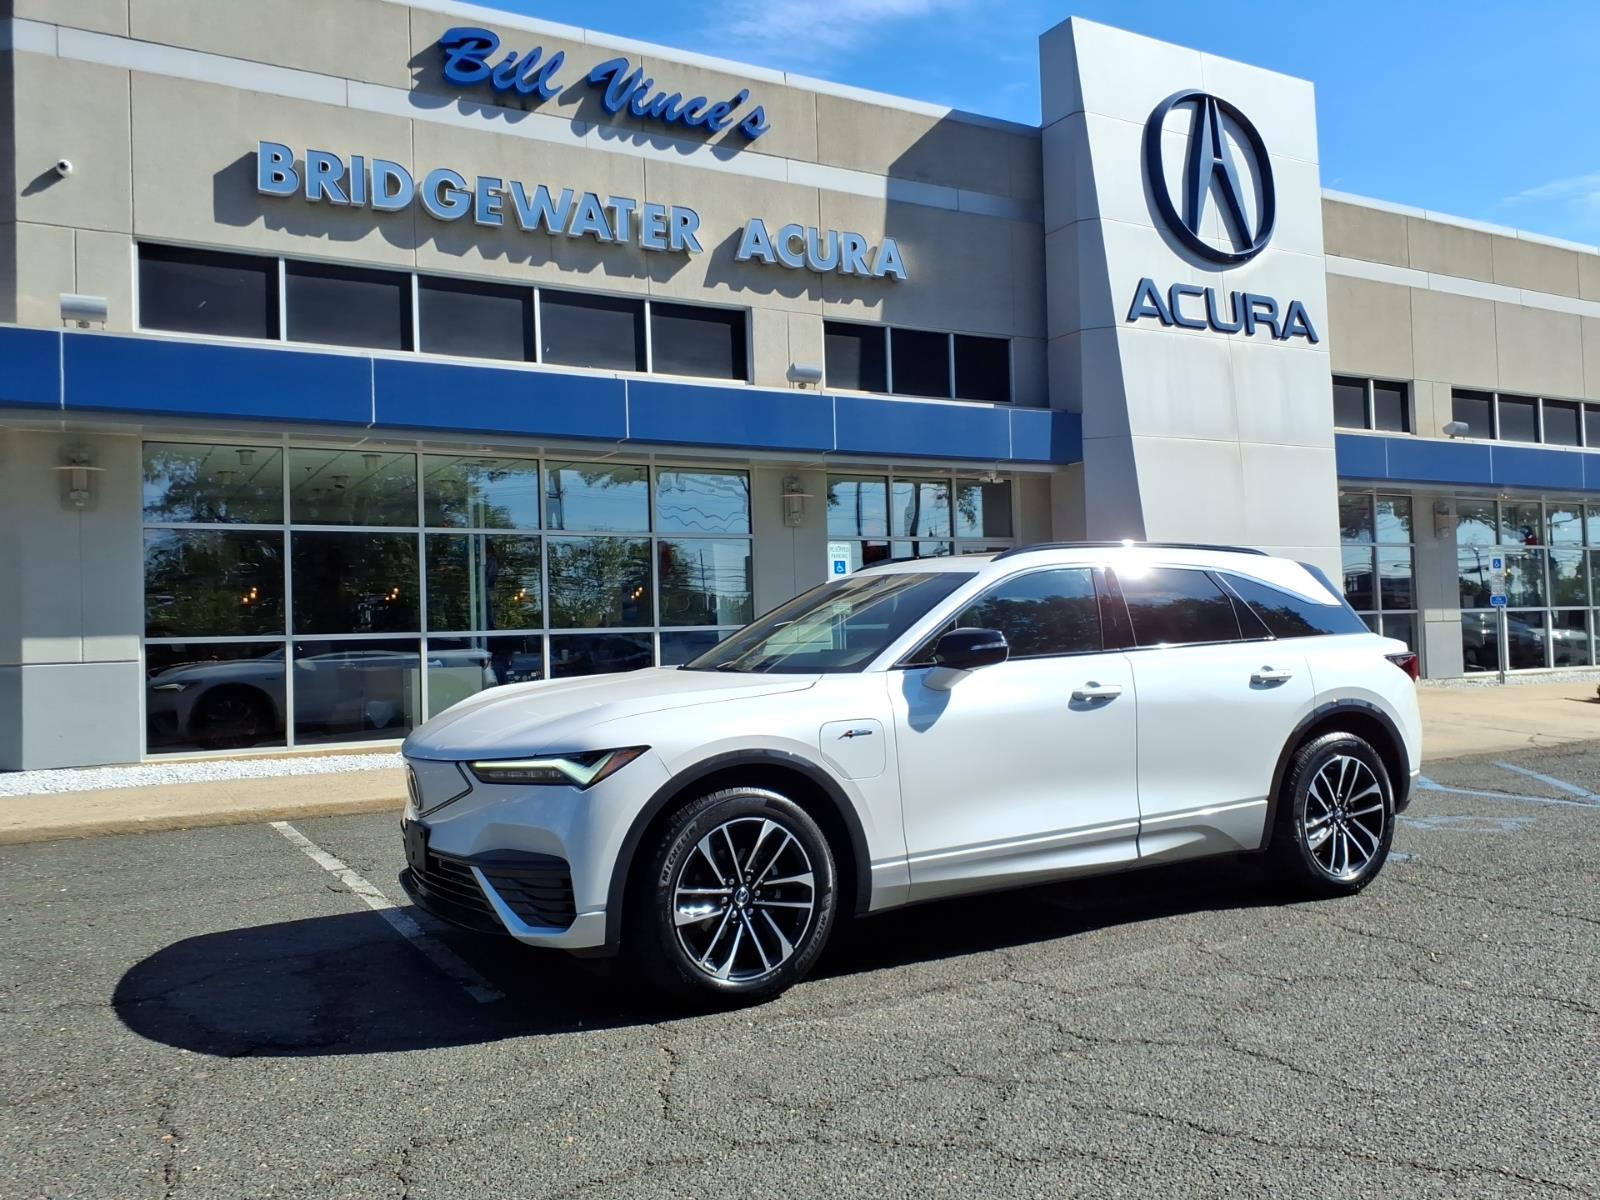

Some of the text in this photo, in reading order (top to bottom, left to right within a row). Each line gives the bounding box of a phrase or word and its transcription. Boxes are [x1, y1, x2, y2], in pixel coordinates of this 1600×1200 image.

[438, 27, 771, 141] Bill Vince's
[256, 140, 909, 281] BRIDGEWATER ACURA
[1126, 277, 1320, 344] ACURA
